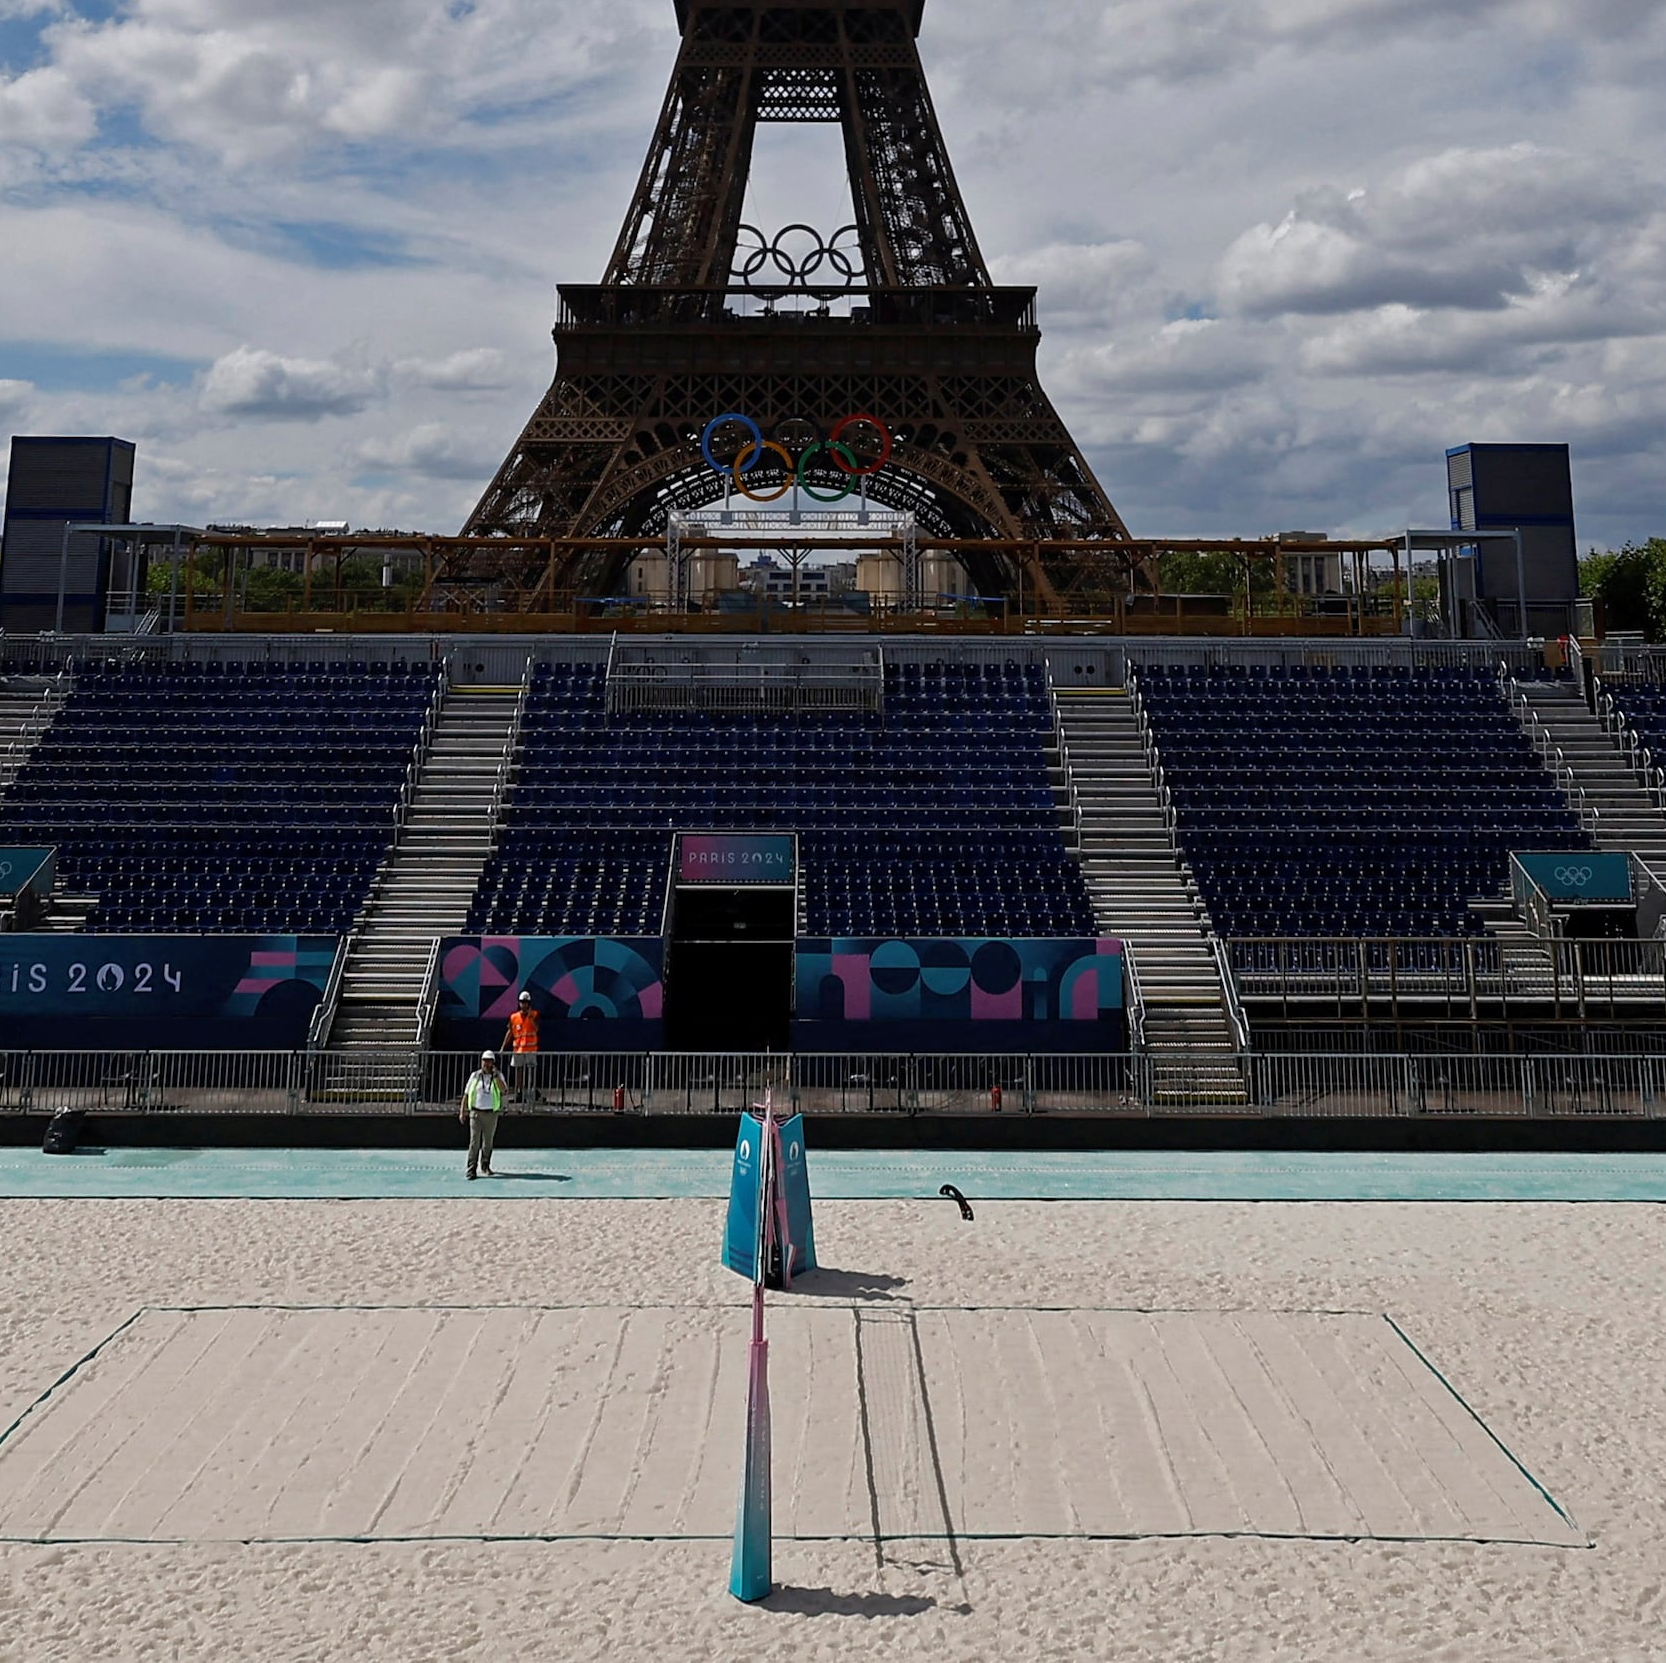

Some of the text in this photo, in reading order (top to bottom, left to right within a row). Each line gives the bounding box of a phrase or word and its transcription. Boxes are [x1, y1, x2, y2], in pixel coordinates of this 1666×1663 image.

[689, 852, 784, 864] PARIS 2024
[67, 963, 182, 993] 2024
